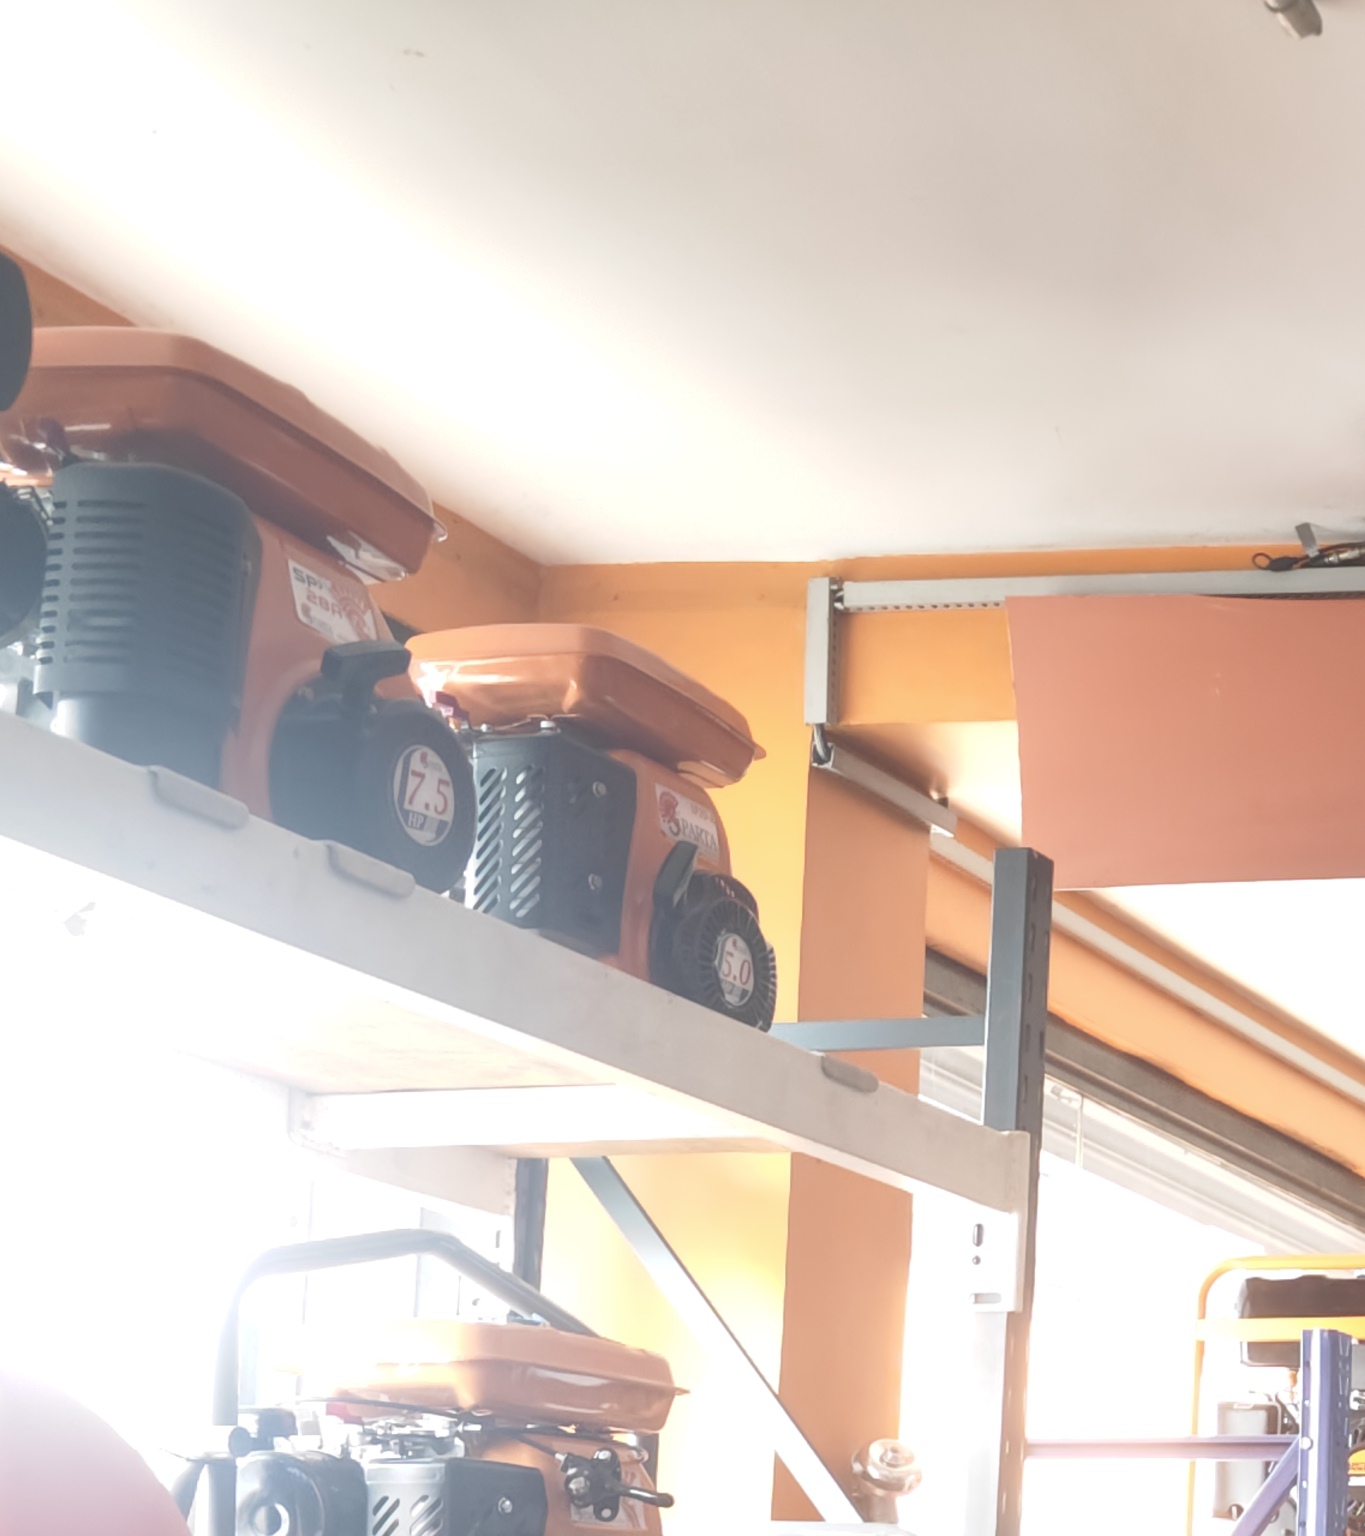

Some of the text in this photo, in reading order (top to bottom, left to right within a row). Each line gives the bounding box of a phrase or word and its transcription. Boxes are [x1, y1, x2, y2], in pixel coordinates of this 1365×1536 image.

[408, 770, 450, 814] 7.5
[408, 812, 424, 828] HP
[722, 952, 750, 986] 5.0
